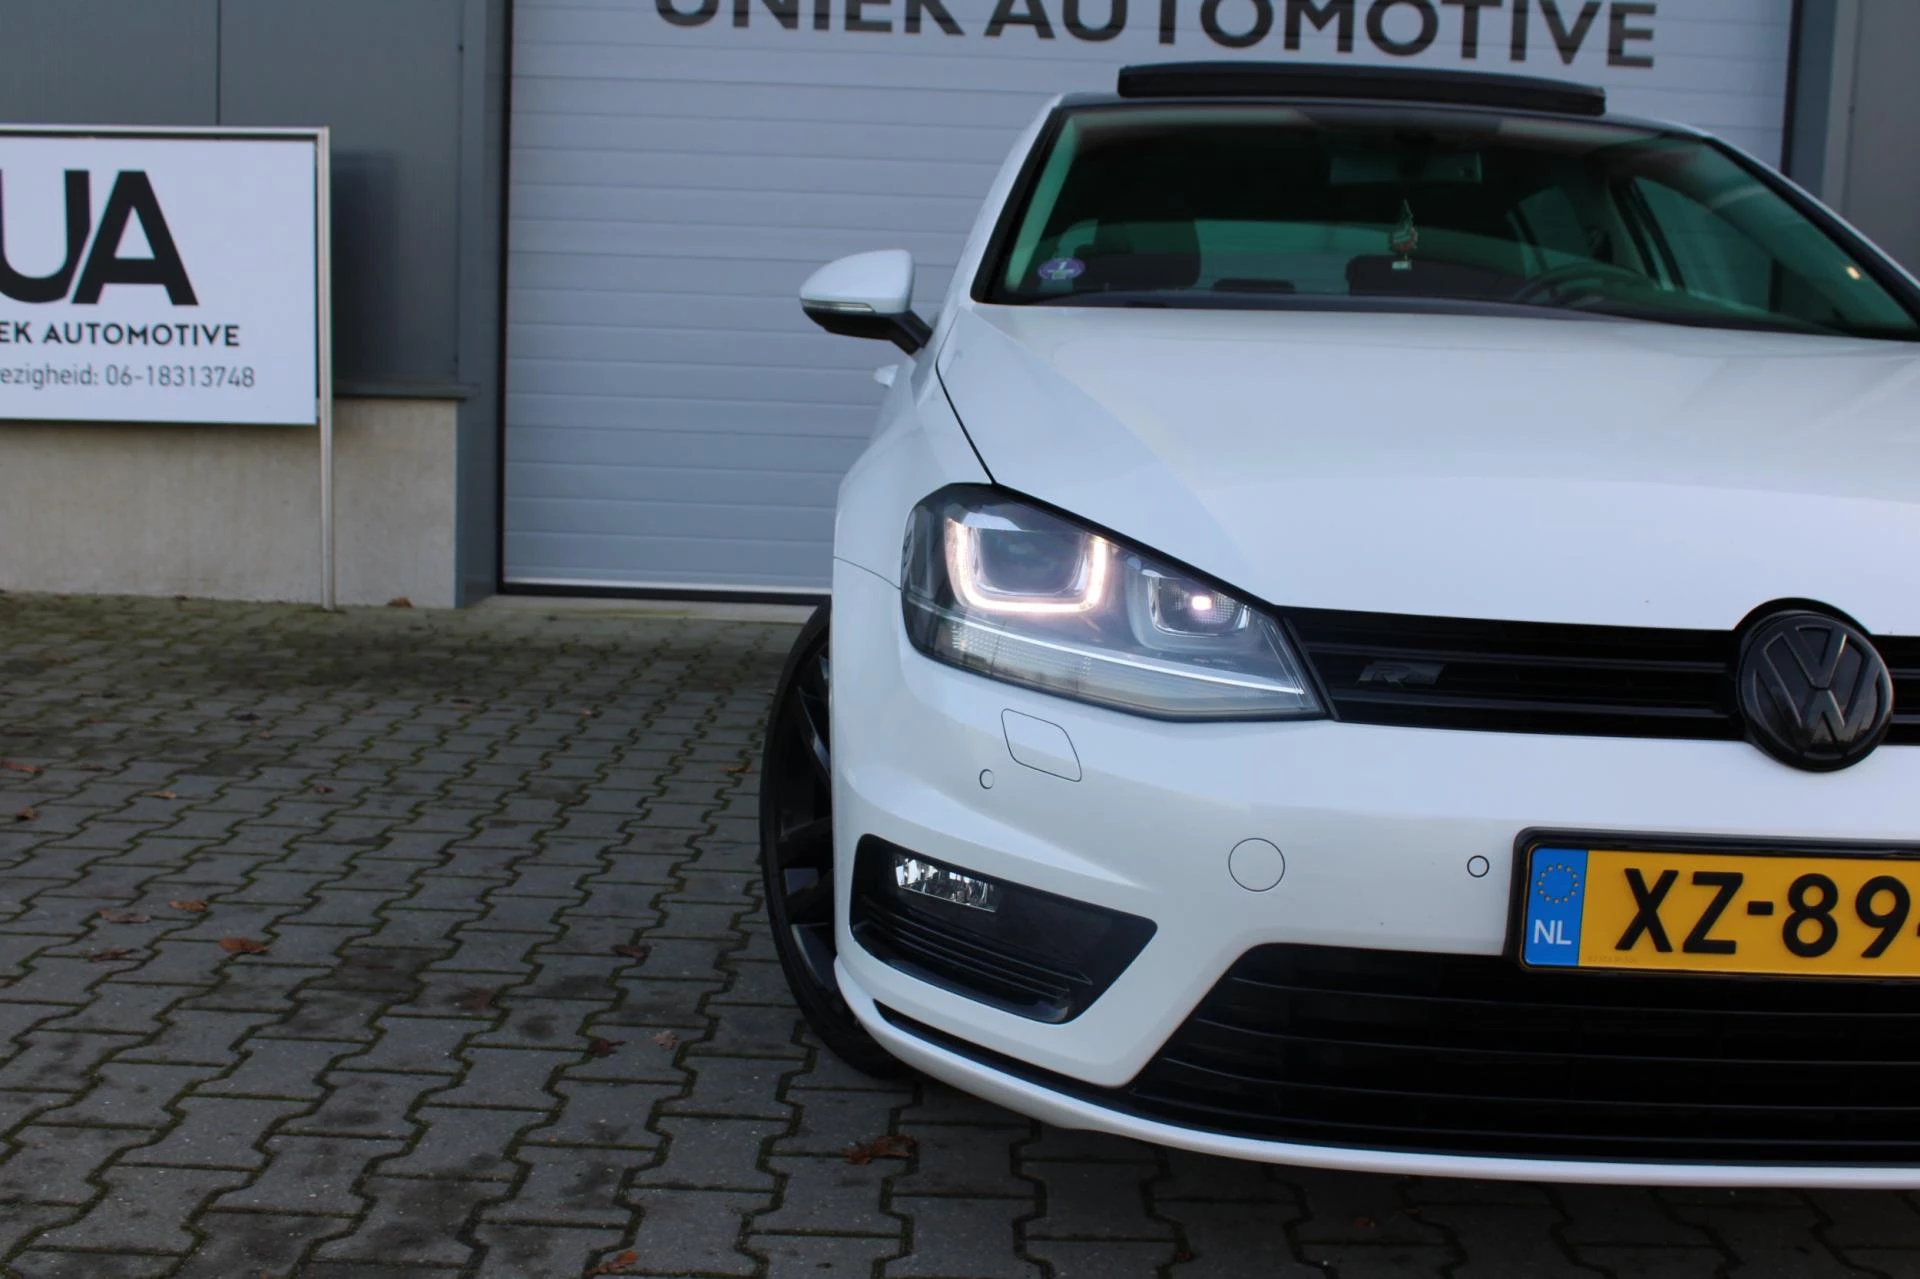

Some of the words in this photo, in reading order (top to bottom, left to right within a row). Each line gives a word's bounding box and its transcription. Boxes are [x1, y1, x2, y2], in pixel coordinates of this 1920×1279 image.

[984, 0, 1654, 68] AUTOMOTIVE
[0, 169, 199, 306] UA
[42, 322, 240, 346] AUTOMOTIVE
[0, 362, 99, 389] ezigheid:
[105, 363, 255, 388] 06-18313748
[1534, 919, 1572, 945] NL
[1613, 867, 1920, 960] XZ-89
